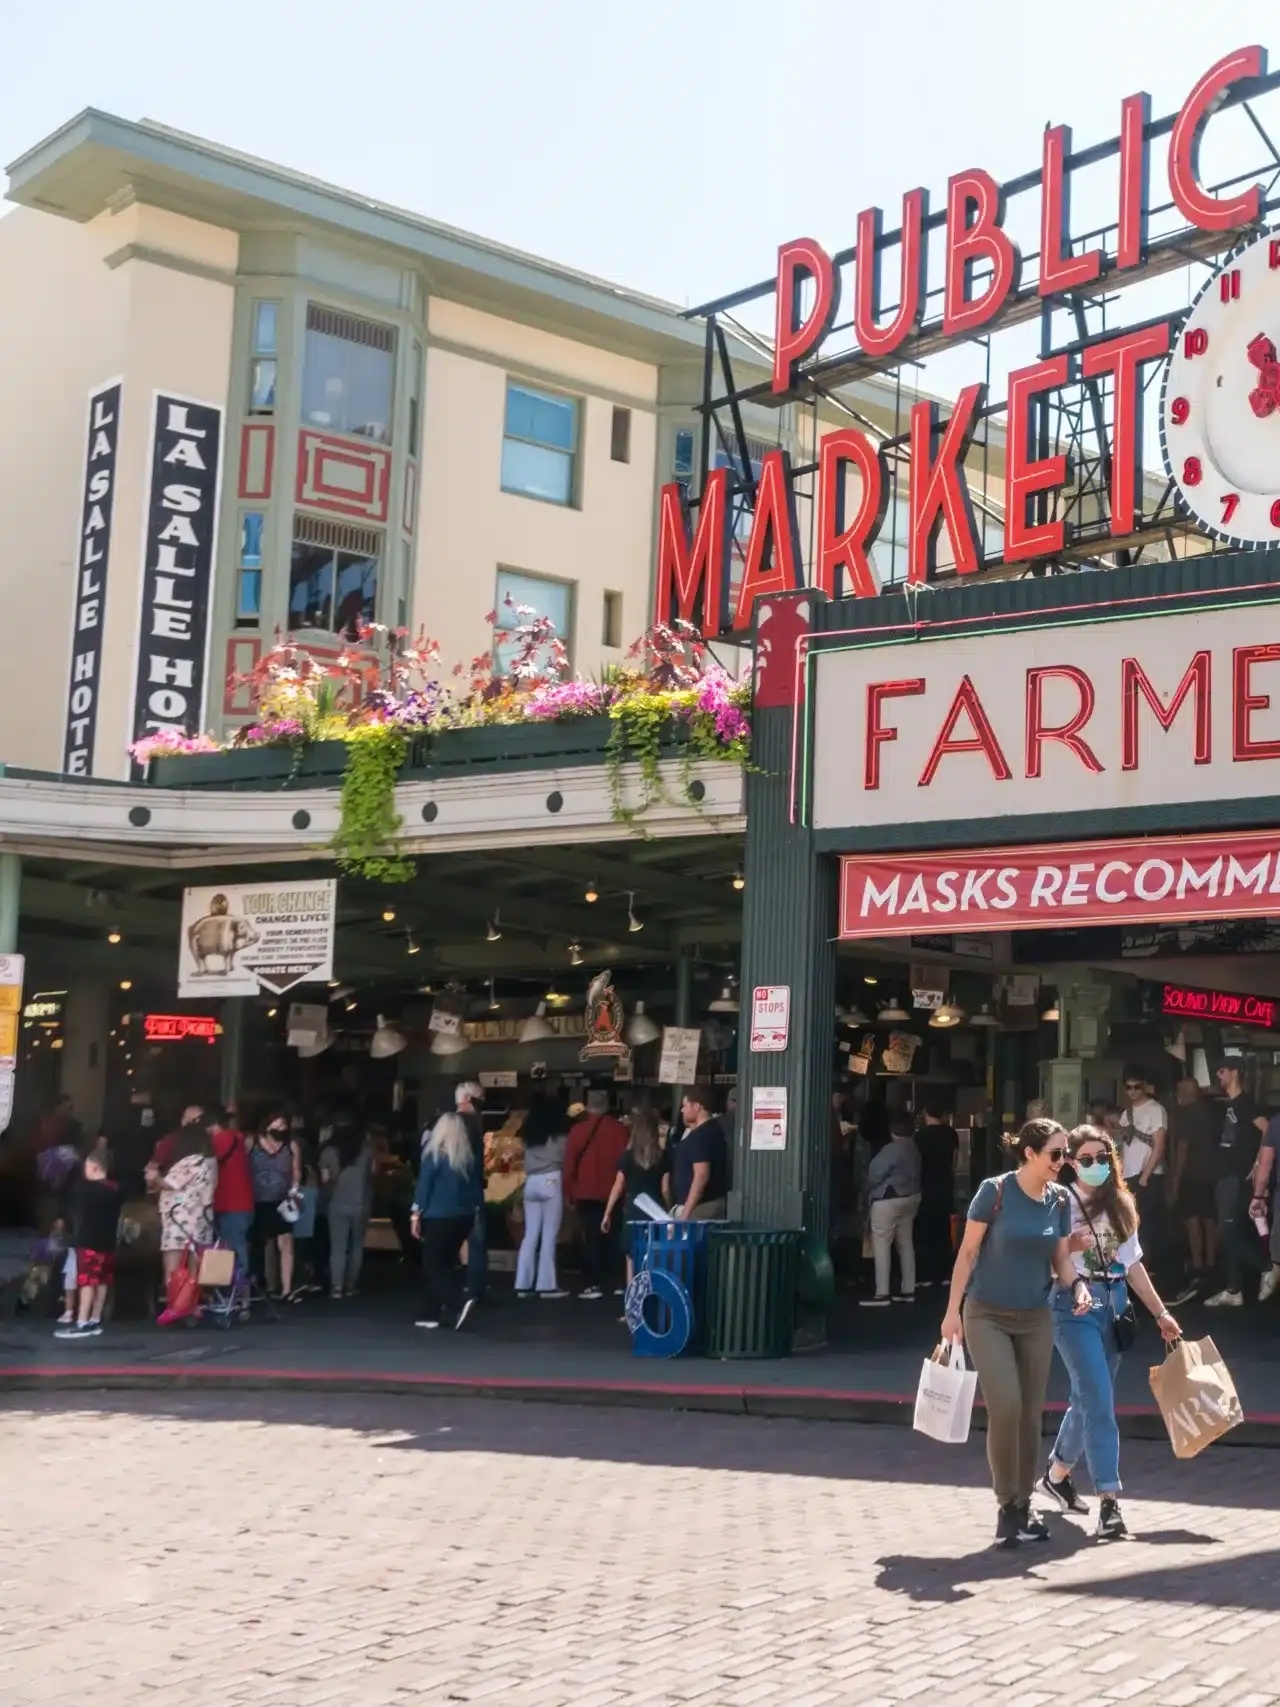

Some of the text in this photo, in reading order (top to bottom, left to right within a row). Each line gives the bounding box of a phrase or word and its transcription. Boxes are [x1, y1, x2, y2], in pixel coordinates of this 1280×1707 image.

[773, 44, 1268, 394] PUBLIC
[1220, 269, 1241, 303] 11
[1184, 328, 1208, 360] 10
[1171, 397, 1190, 426] 9
[656, 322, 1171, 638] MARKET
[1182, 456, 1203, 487] 8
[1220, 493, 1240, 524] 7
[80, 470, 110, 631] SALLE
[150, 483, 202, 640] SALLE
[860, 867, 1019, 917] MASKS
[756, 989, 768, 999] NO
[758, 1002, 785, 1013] STOPS
